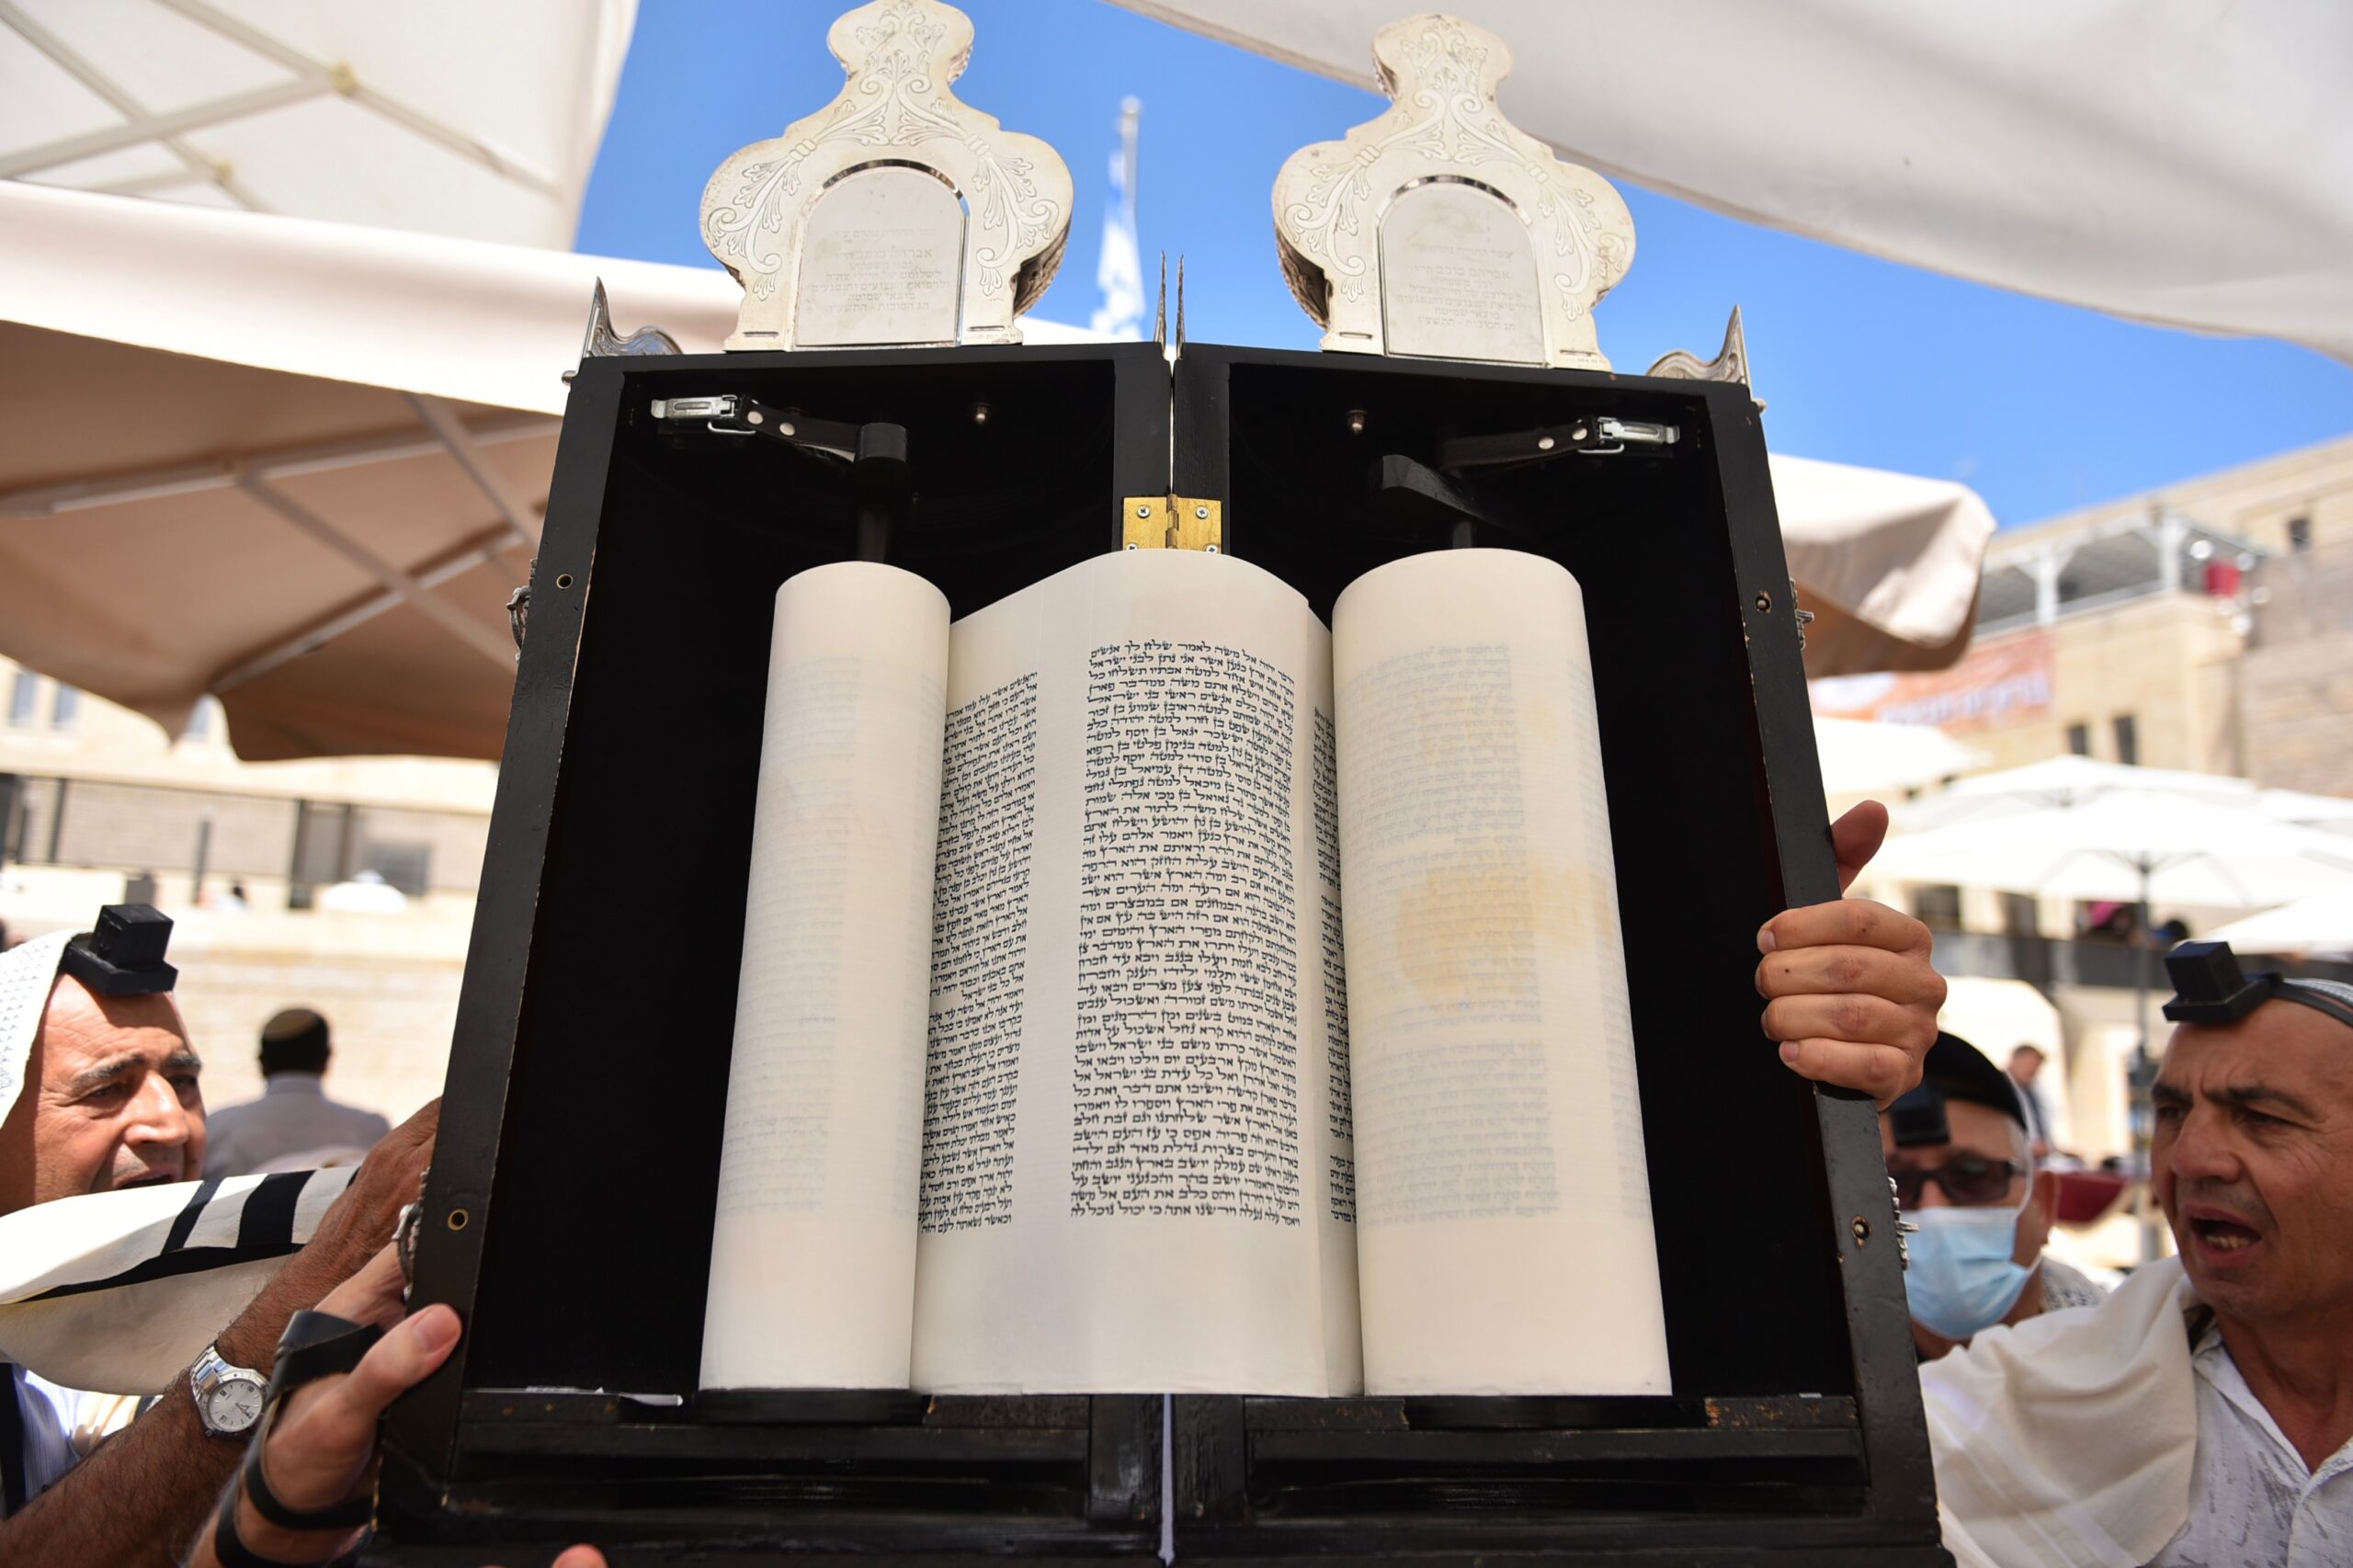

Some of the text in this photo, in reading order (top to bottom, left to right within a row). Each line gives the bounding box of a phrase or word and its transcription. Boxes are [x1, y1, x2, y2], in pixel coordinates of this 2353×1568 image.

[1089, 644, 1120, 659] אנשים
[1177, 641, 1211, 653] לאמר
[1088, 655, 1126, 671] ישראל
[1108, 664, 1147, 678] תשלחו
[1089, 682, 1115, 697] פארן
[1119, 679, 1165, 688] ממדבר
[1088, 691, 1232, 706] אנשים ישראל
[1164, 702, 1196, 713] ראובן
[1110, 715, 1209, 725] חורי יהודה
[1125, 728, 1149, 740] יוסף
[1172, 723, 1198, 736] יגאל
[1165, 739, 1231, 755] למטה בנימן
[1187, 754, 1212, 763] סודי
[1131, 762, 1172, 775] עמיאל
[1197, 766, 1232, 779] למטה
[1108, 774, 1221, 790] מיכאל נפתלי
[1086, 788, 1229, 805] גאואל שמות
[1085, 800, 1178, 822] לתור הארץ
[1112, 814, 1148, 827] וישלח
[1152, 816, 1188, 827] יהושע
[1159, 829, 1222, 842] כנען ויאמר
[1099, 844, 1205, 858] וראיתם הארץ
[1151, 856, 1181, 868] החזק
[1186, 853, 1217, 869] עליה
[1165, 869, 1226, 882] ומה הארץ
[1116, 883, 1155, 894] הערים
[1080, 902, 1100, 912] ומה
[1106, 898, 1165, 910] במבצרים
[1186, 911, 1209, 921] רזה
[1101, 926, 1222, 937] מפרי והימים
[1204, 940, 1234, 952] ויתרו
[1135, 949, 1227, 965] ויעלו בנגב ויבא
[1164, 962, 1236, 981] ותלמי ילידי
[1101, 982, 1176, 993] מצרים ויבאו
[1077, 993, 1205, 1010] זמורה ואשכול ענבים
[1101, 1010, 1222, 1022] בשנים הרמנים
[1124, 1021, 1165, 1035] אשכול
[1075, 1036, 1152, 1053] ישראל וישבו
[1097, 1050, 1233, 1067] ארבעים וילכו ויבאו
[1096, 1066, 1136, 1080] ישראל
[1187, 1084, 1222, 1095] וישיבו
[1074, 1097, 1213, 1111] הארץ ויספרו ויאמרו
[1154, 1108, 1207, 1122] שלחתנו
[1074, 1130, 1108, 1141] הישב
[1162, 1138, 1198, 1153] גדלת
[1072, 1160, 1102, 1170] והחתי
[1177, 1157, 1209, 1169] יושב
[1127, 1172, 1173, 1185] והכנעני
[1178, 1184, 1234, 1200] ויהס כלב
[1088, 1200, 1236, 1216] וירשנו יכול נוכל
